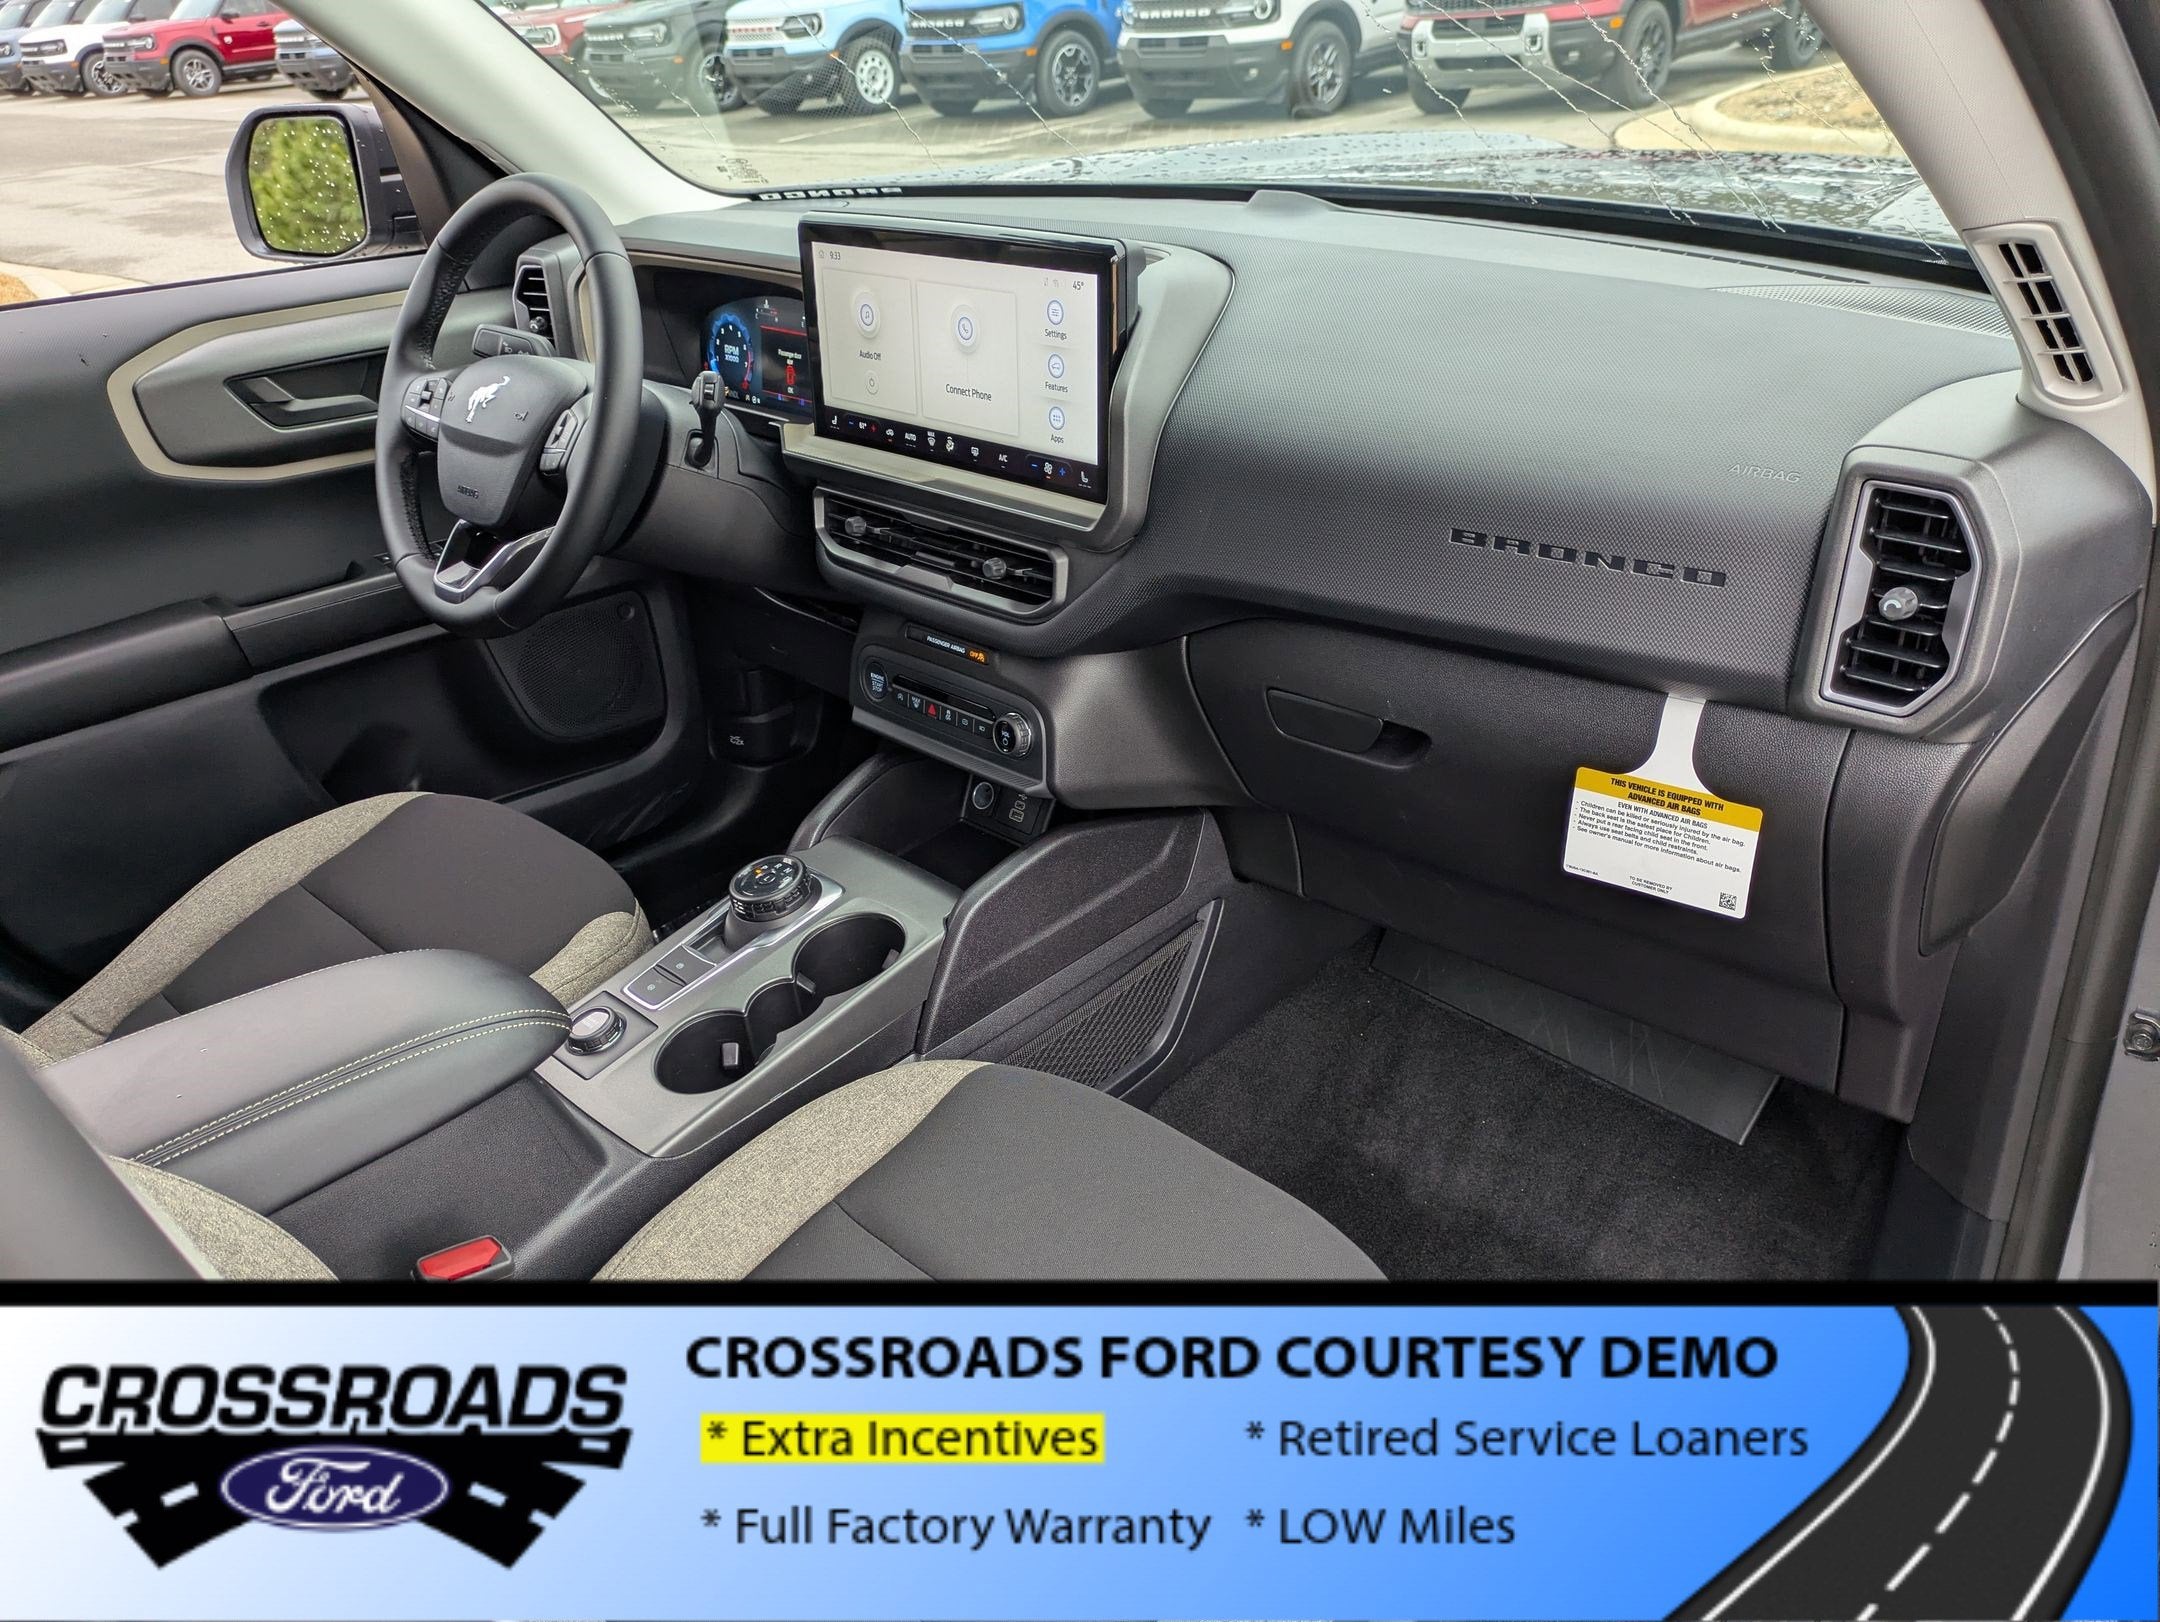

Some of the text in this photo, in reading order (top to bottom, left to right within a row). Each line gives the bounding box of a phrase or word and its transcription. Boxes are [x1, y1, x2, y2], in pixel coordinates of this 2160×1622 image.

[1139, 7, 1210, 19] BRONCO
[829, 251, 841, 260] 9:33
[1072, 281, 1084, 291] 45°
[1044, 328, 1068, 340] Settings
[724, 344, 740, 356] RPM
[859, 350, 881, 361] Audio Off
[946, 383, 992, 402] Connect Phone
[1045, 381, 1069, 393] Features
[904, 432, 917, 442] AUTO
[1051, 434, 1064, 444] Apps
[998, 454, 1008, 462] A/C
[1728, 462, 1802, 484] AIRBAG
[1449, 527, 1728, 588] BRONCO
[926, 635, 951, 649] PASSENGER
[950, 644, 966, 654] AIRBAG
[1610, 777, 1724, 810] THIS VEHICLE IS EQUIPPED WITH
[1627, 792, 1701, 815] ADVANCED AIR BAGS
[1580, 800, 1604, 811] Children
[1625, 812, 1641, 820] killed
[1650, 818, 1677, 830] seriously
[1678, 825, 1700, 835] injured
[1731, 838, 1745, 847] bag.
[1617, 801, 1632, 810] EVEN
[1633, 805, 1648, 814] WITH
[1649, 809, 1679, 822] ADVANCED
[1691, 820, 1707, 829] BAGS
[1577, 819, 1598, 829] Always
[1624, 831, 1638, 839] belts
[1652, 838, 1666, 846] child
[1667, 843, 1698, 854] restraints.
[1578, 813, 1595, 821] Never
[1624, 825, 1642, 834] facing
[1691, 842, 1708, 850] front.
[1636, 821, 1654, 830] safest
[1655, 826, 1672, 835] place
[1683, 833, 1710, 844] Children.
[1588, 829, 1611, 838] owner's
[1612, 835, 1633, 844] manual
[1660, 847, 1694, 860] information
[1695, 857, 1713, 865] about
[1724, 864, 1740, 873] bags.
